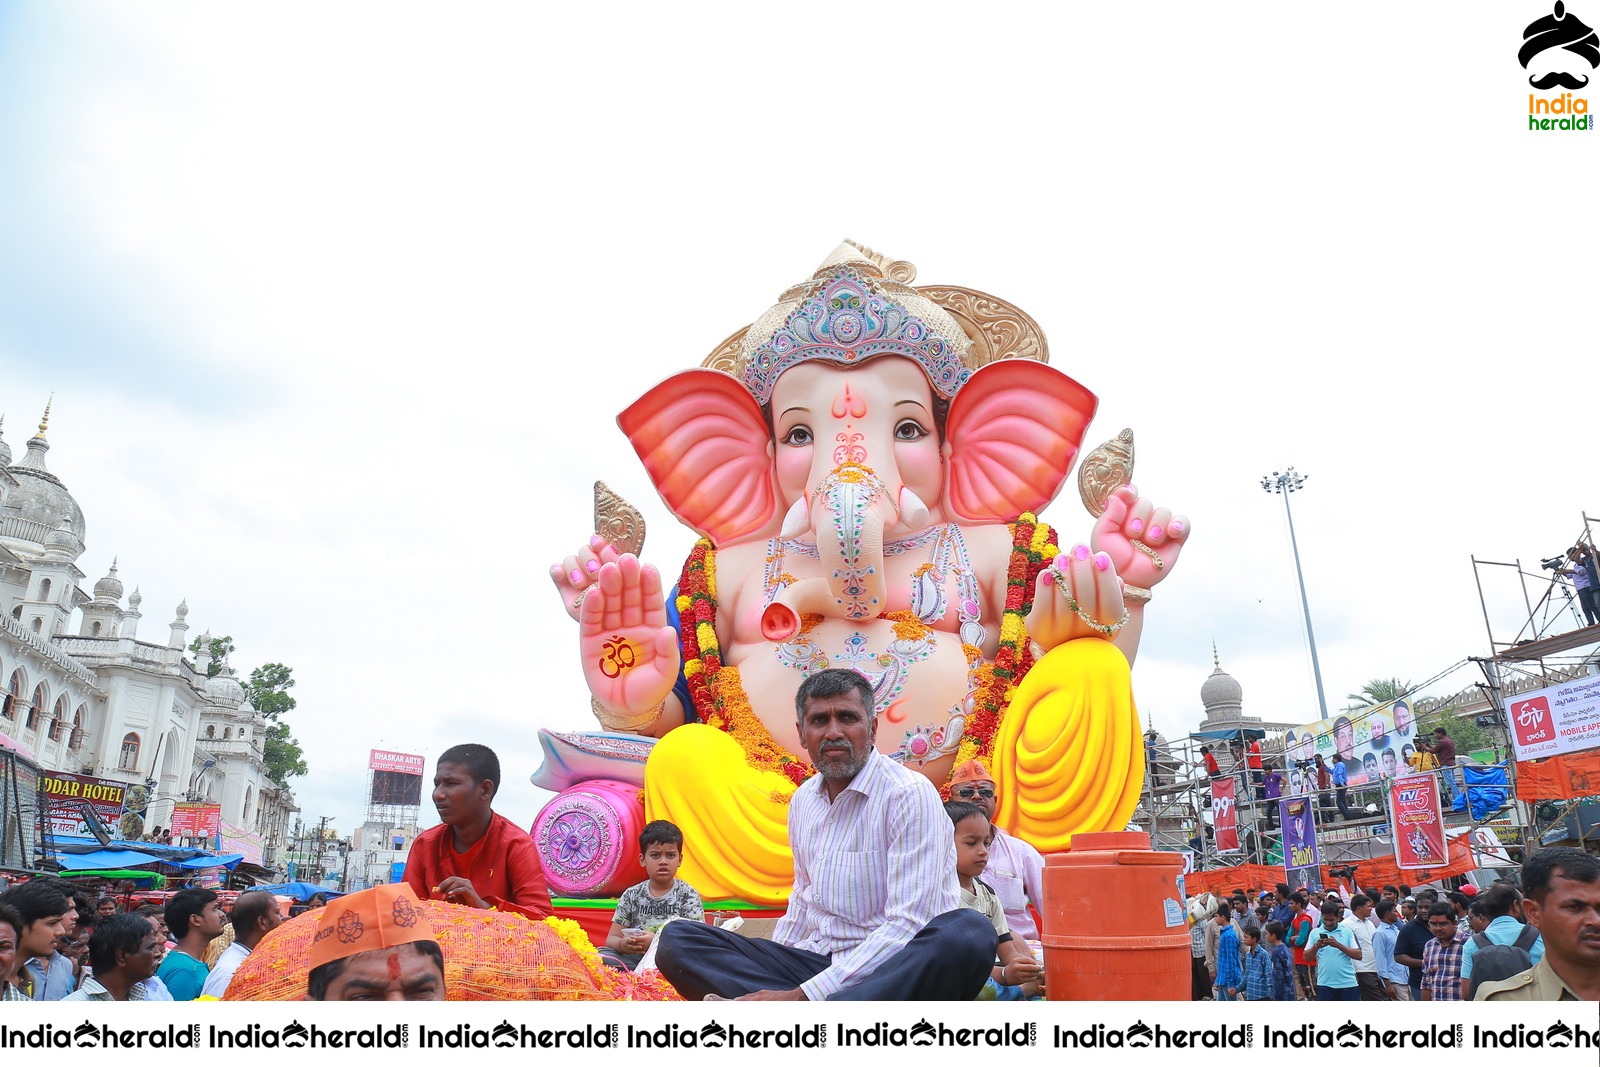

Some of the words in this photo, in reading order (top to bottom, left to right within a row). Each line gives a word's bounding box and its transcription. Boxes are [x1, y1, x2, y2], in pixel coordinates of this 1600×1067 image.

[1560, 725, 1587, 737] MOBILE
[374, 752, 404, 763] BHASKAR
[404, 757, 421, 766] ARTS
[82, 783, 122, 803] HOTEL
